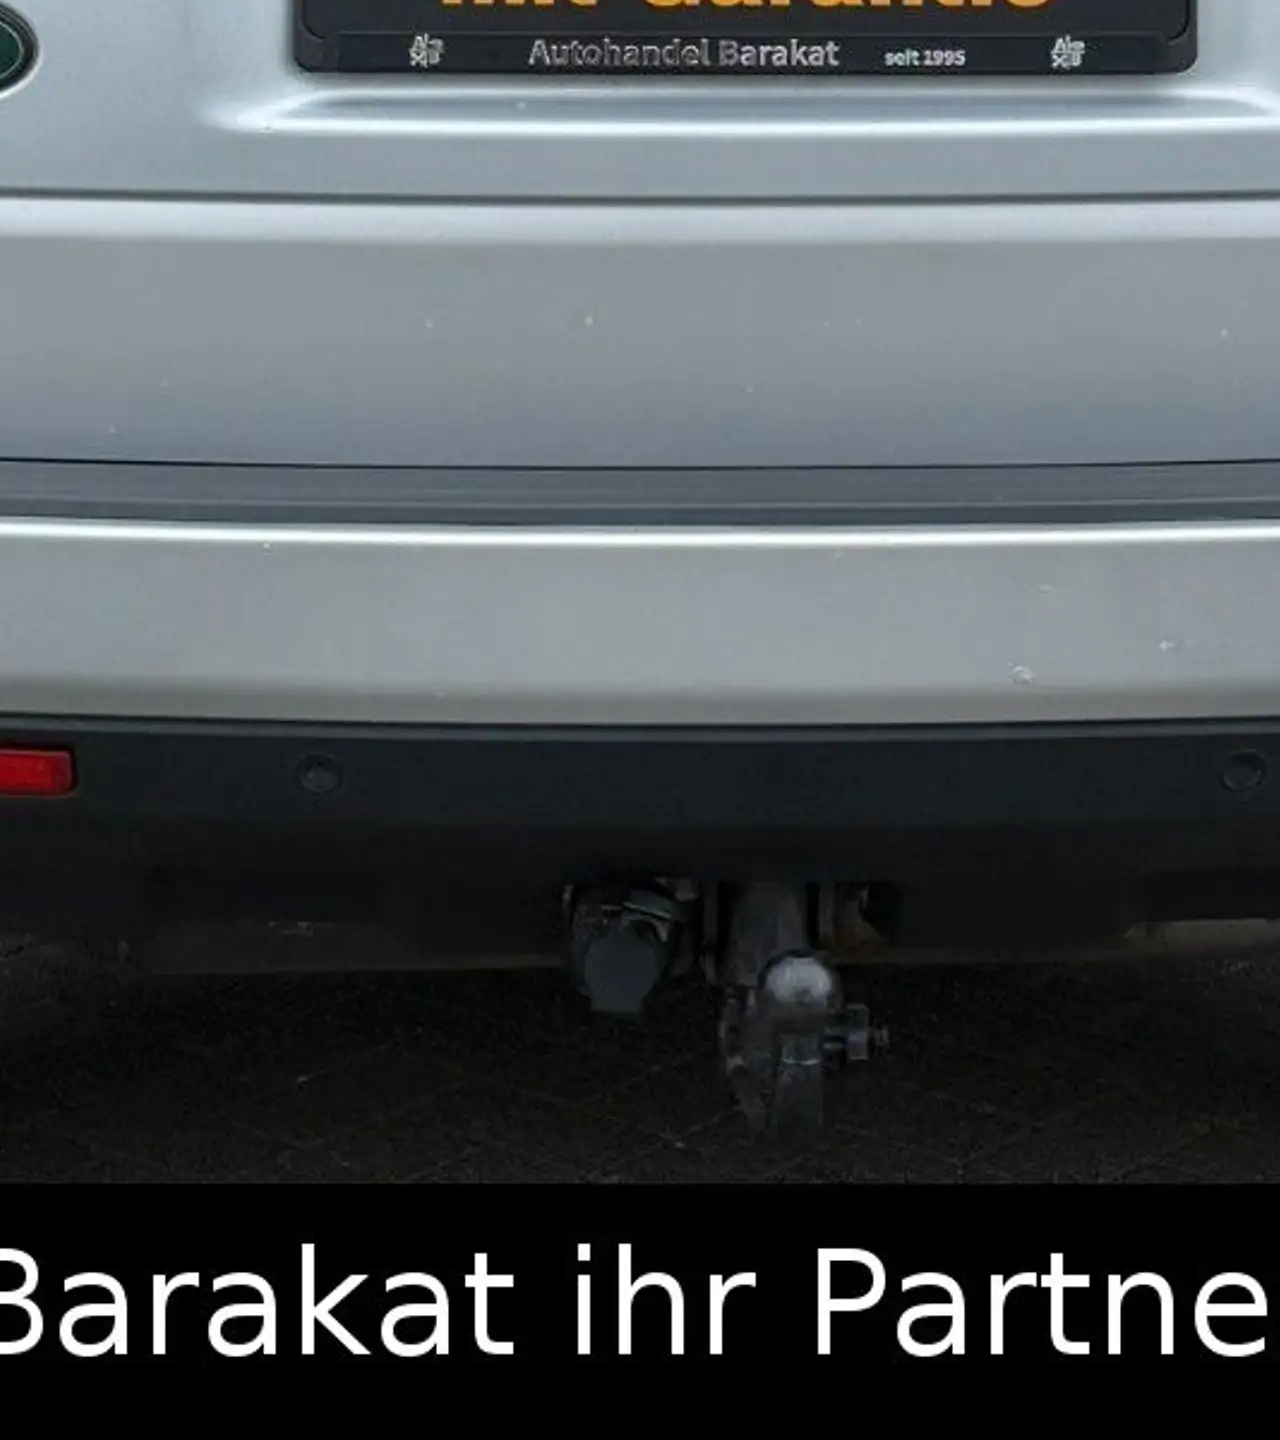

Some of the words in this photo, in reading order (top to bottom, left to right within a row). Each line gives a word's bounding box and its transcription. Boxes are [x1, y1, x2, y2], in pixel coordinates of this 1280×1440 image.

[528, 38, 710, 67] Autohandel
[719, 39, 841, 67] Barakat
[883, 49, 920, 67] seit
[923, 49, 966, 67] 1995
